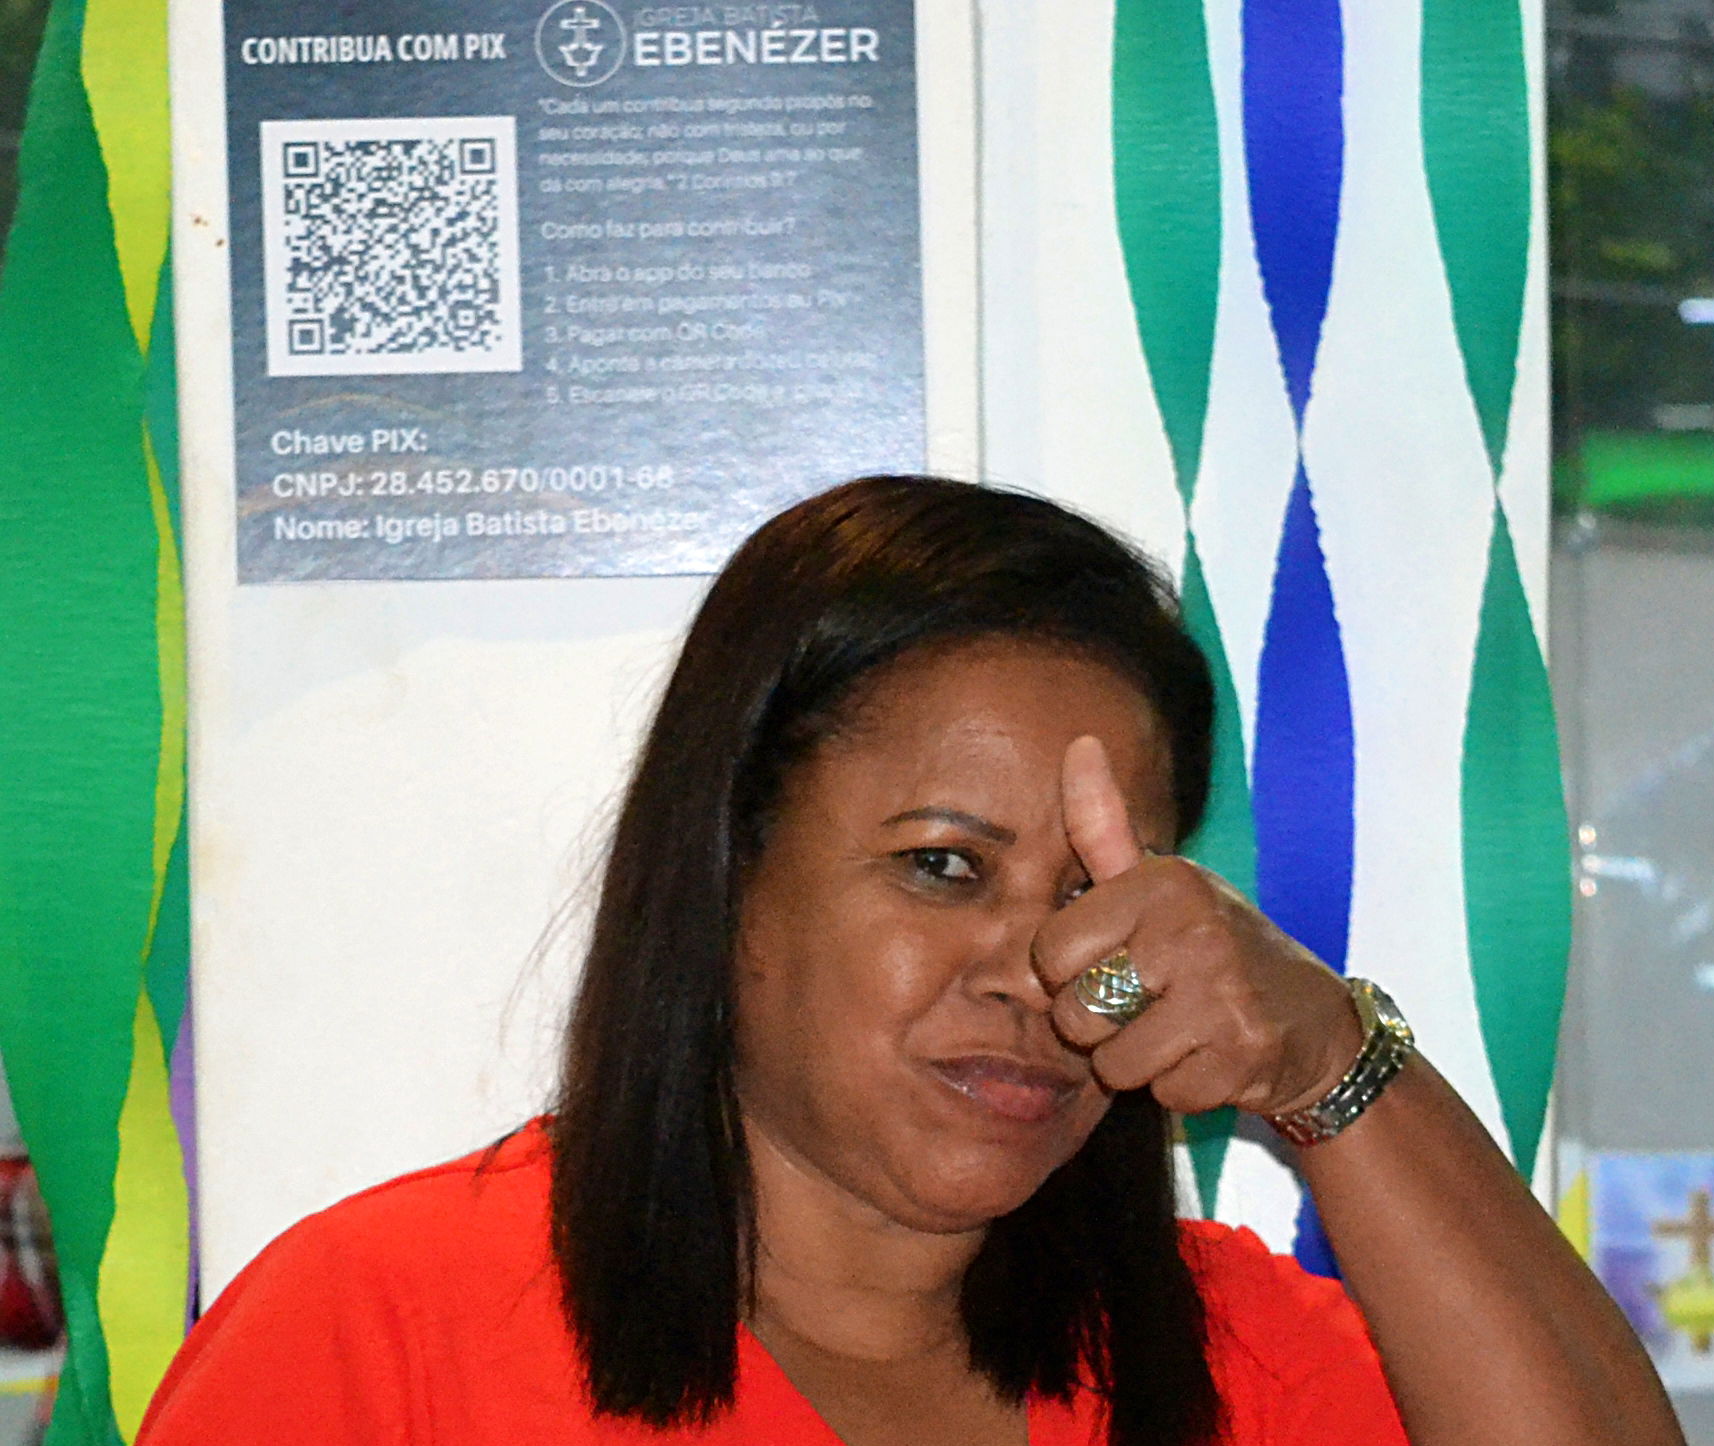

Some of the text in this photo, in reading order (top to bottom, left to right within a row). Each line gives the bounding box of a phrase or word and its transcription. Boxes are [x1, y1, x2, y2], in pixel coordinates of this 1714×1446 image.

[241, 33, 507, 64] CONTRIBUA COM PIX
[634, 20, 880, 66] EBENÉZER
[541, 222, 602, 240] Como
[639, 221, 684, 241] para
[270, 427, 428, 456] Chave PIX:
[272, 472, 364, 499] CNPJ:
[274, 514, 368, 542] Nome:
[376, 511, 458, 545] Igreja
[466, 510, 567, 538] Batista
